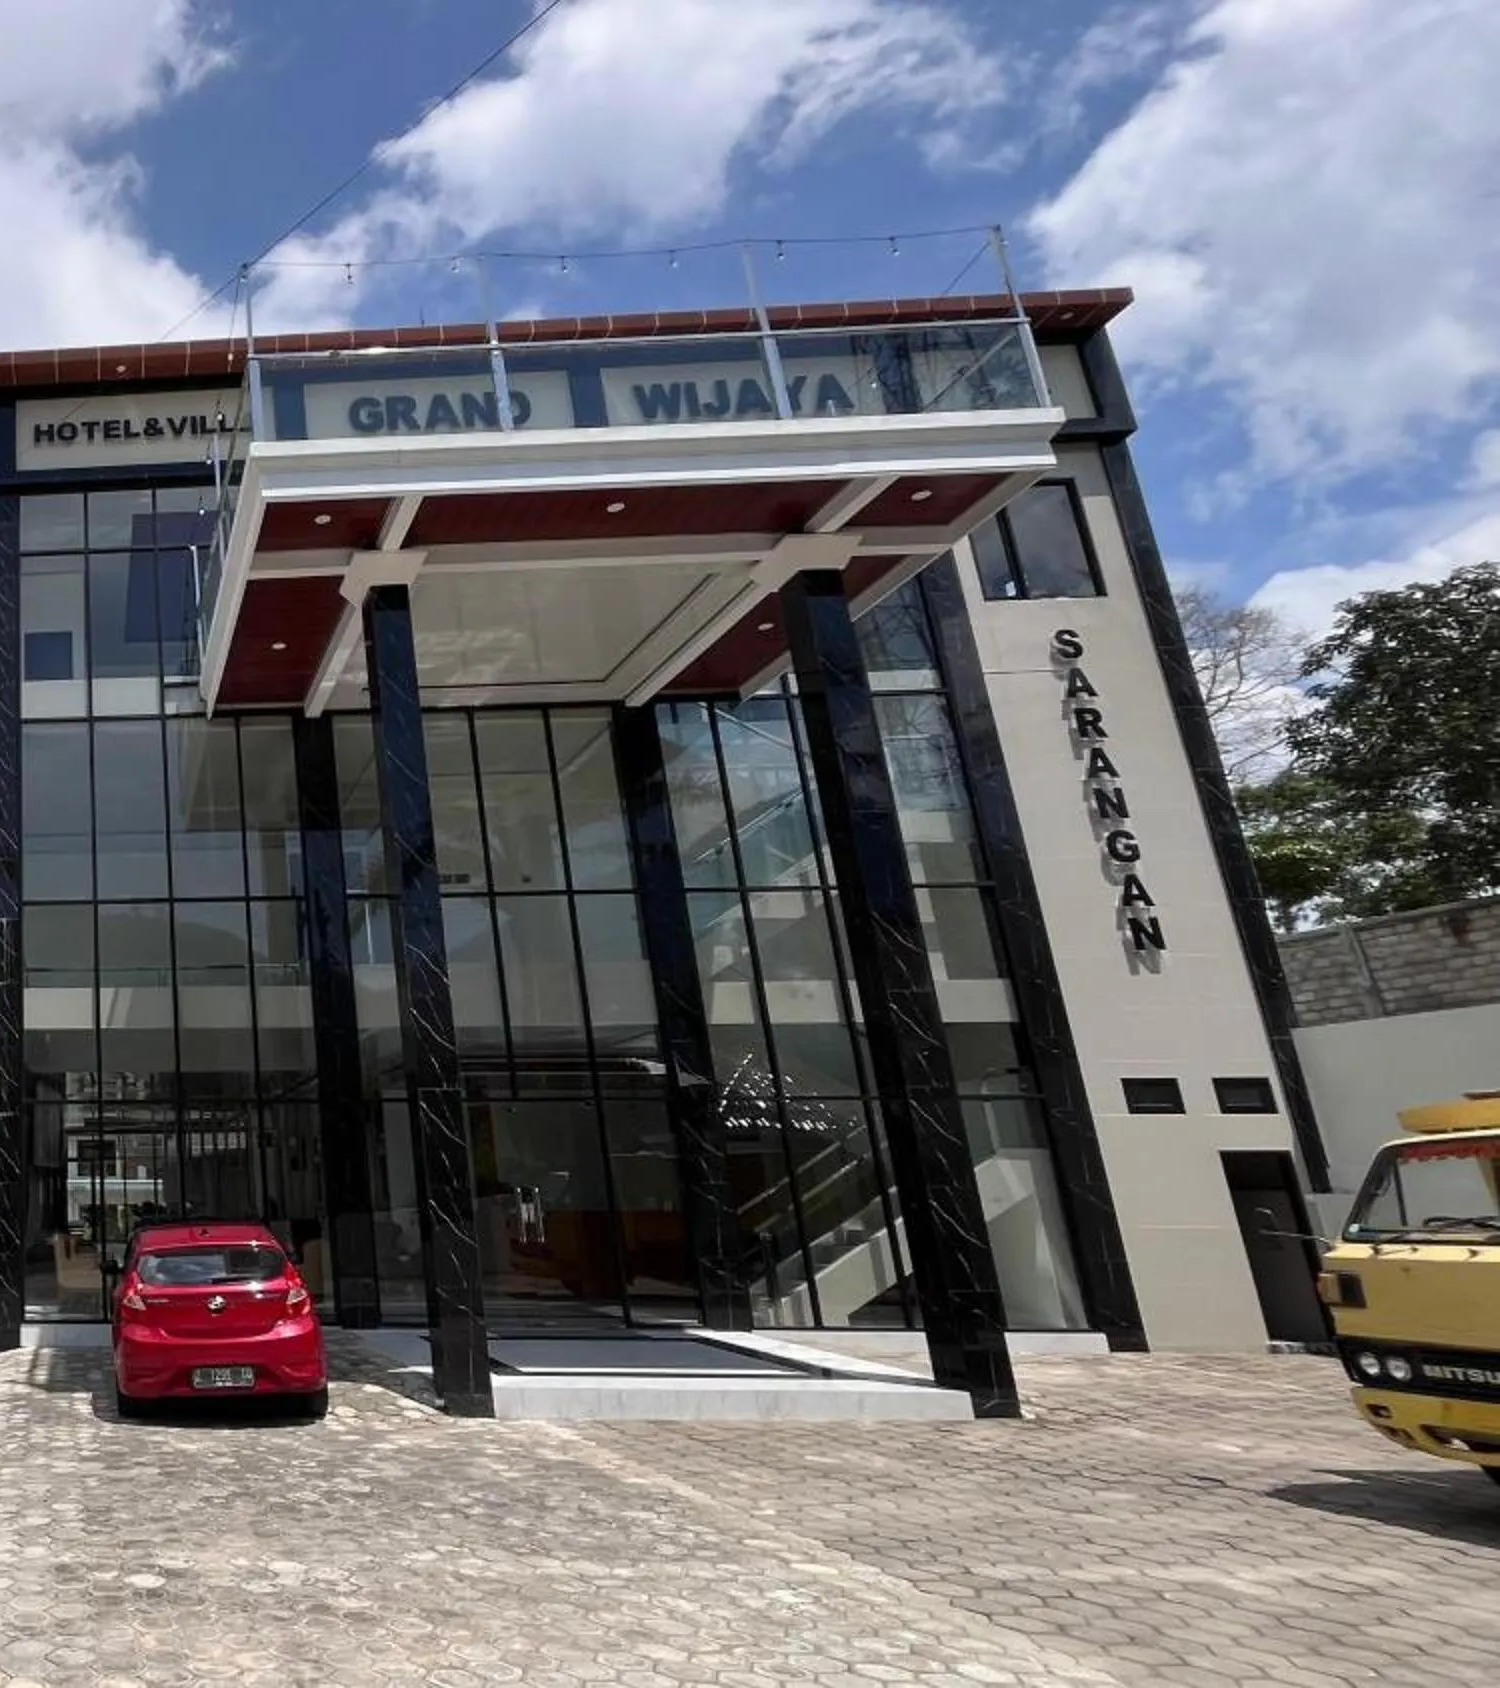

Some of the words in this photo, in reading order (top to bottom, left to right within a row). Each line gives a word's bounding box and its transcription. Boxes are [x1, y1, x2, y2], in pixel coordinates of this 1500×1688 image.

[349, 390, 531, 432] GRAND
[632, 373, 855, 420] WIJAYA
[1053, 629, 1166, 950] SARANGAN
